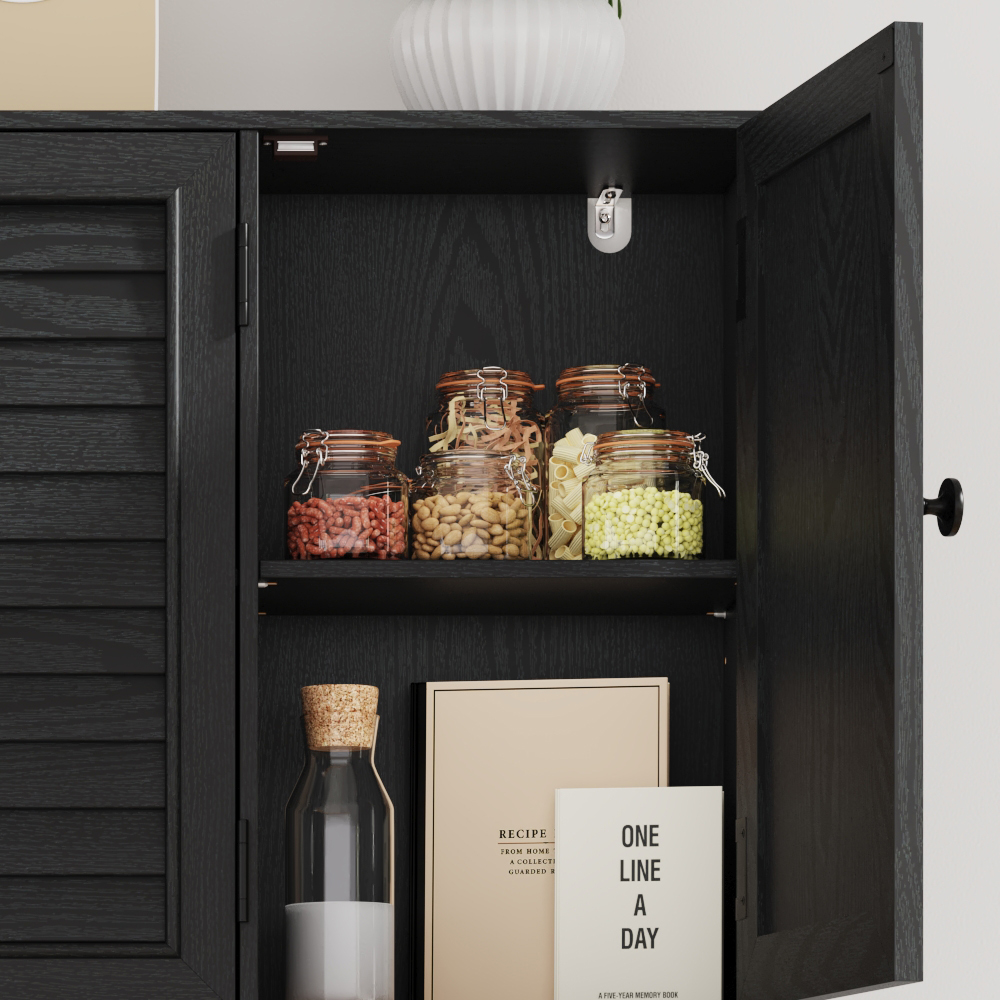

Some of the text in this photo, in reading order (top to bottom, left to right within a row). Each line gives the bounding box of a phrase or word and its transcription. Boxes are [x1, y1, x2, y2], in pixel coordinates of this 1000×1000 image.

[499, 829, 547, 839] RECIPE
[621, 824, 659, 847] ONE
[620, 859, 661, 882] LINE
[633, 893, 647, 916] A
[621, 928, 659, 949] DAY
[662, 991, 679, 999] BOOK
